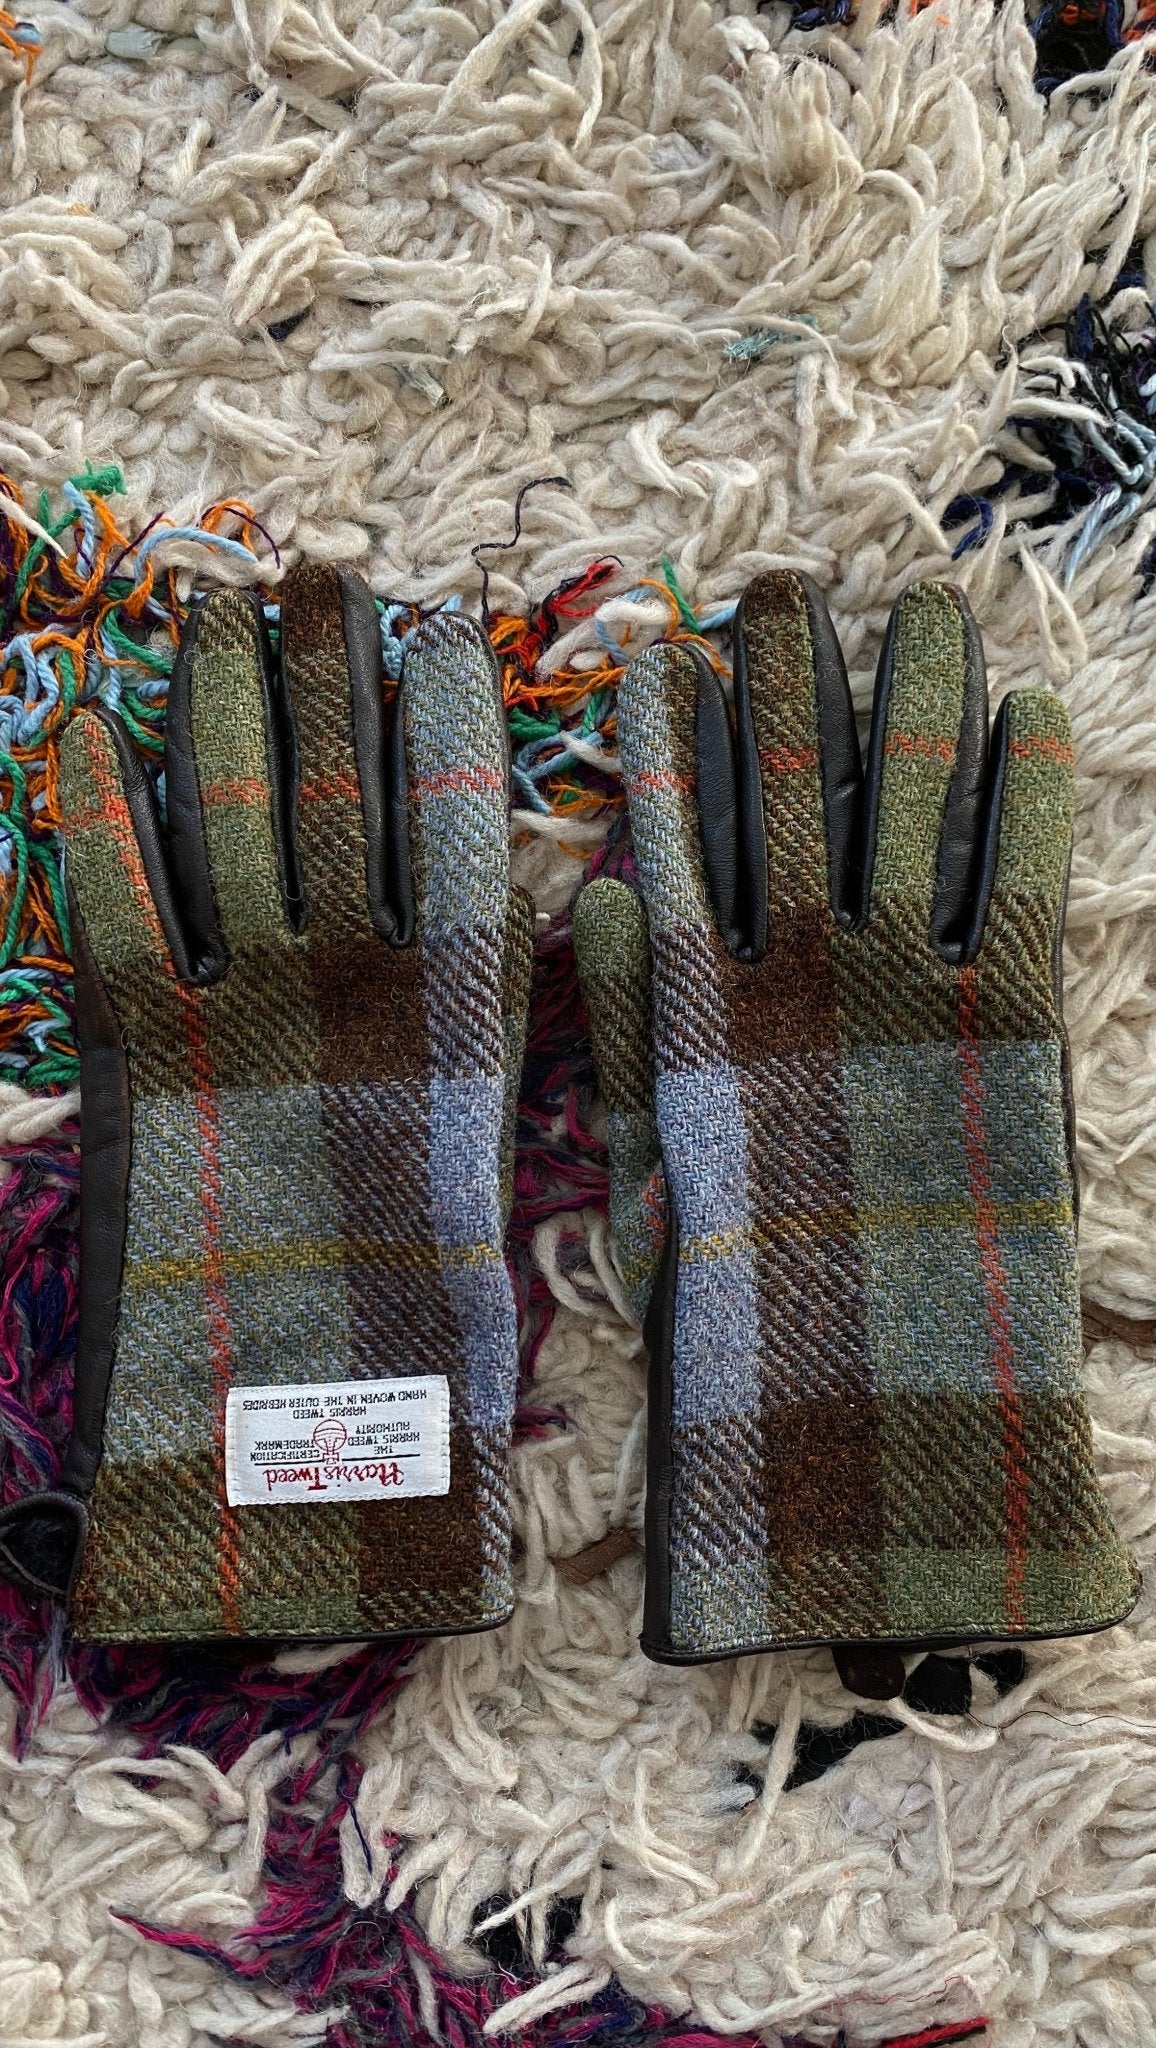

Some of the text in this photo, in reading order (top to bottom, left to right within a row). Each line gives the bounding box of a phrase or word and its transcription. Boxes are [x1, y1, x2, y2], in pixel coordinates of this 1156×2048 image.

[243, 1390, 426, 1410] HAND WOVEN IN THE OUTER HEBRIDES
[293, 1406, 366, 1419] HARRIS TWEED
[356, 1422, 410, 1434] AUTHORITY
[255, 1439, 315, 1450] TRADEMARK
[348, 1432, 419, 1446] HARRIS TWEED
[250, 1450, 319, 1461] CERTIFICATION
[374, 1446, 393, 1454] THE
[263, 1463, 404, 1491] Harris Tweed
